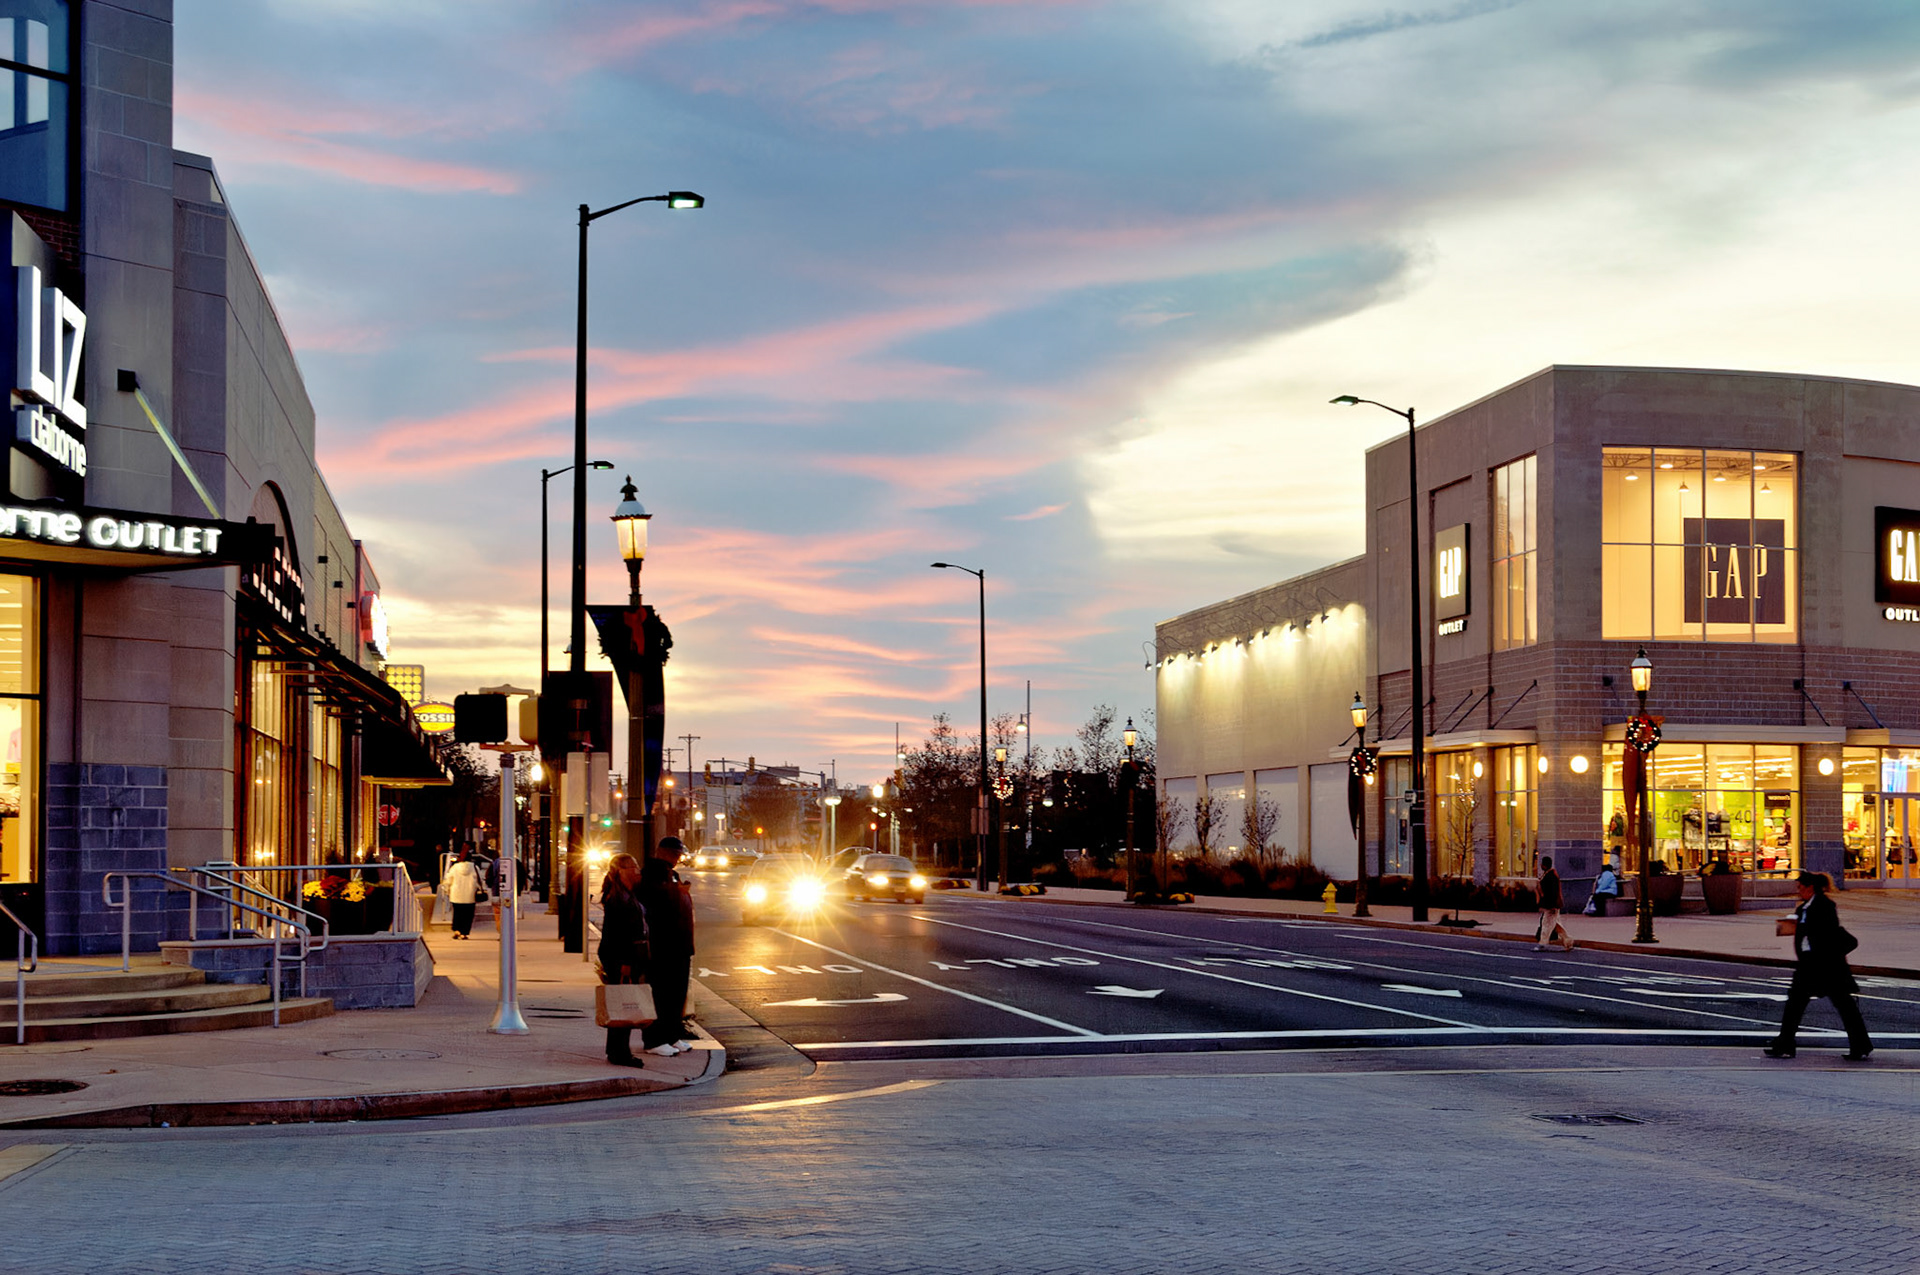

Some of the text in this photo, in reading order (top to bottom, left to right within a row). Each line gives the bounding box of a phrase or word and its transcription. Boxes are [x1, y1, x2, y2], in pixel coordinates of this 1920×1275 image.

[22, 265, 87, 430] LIZ
[88, 516, 222, 554] OUTLET
[1890, 529, 1920, 582] GA
[1440, 546, 1462, 598] GAP
[1703, 542, 1768, 599] GAP
[1439, 619, 1464, 636] OUTLET
[379, 811, 397, 819] STP
[698, 964, 864, 977] ONLY
[928, 957, 1100, 970] ONLY
[1172, 957, 1355, 969] ONLY
